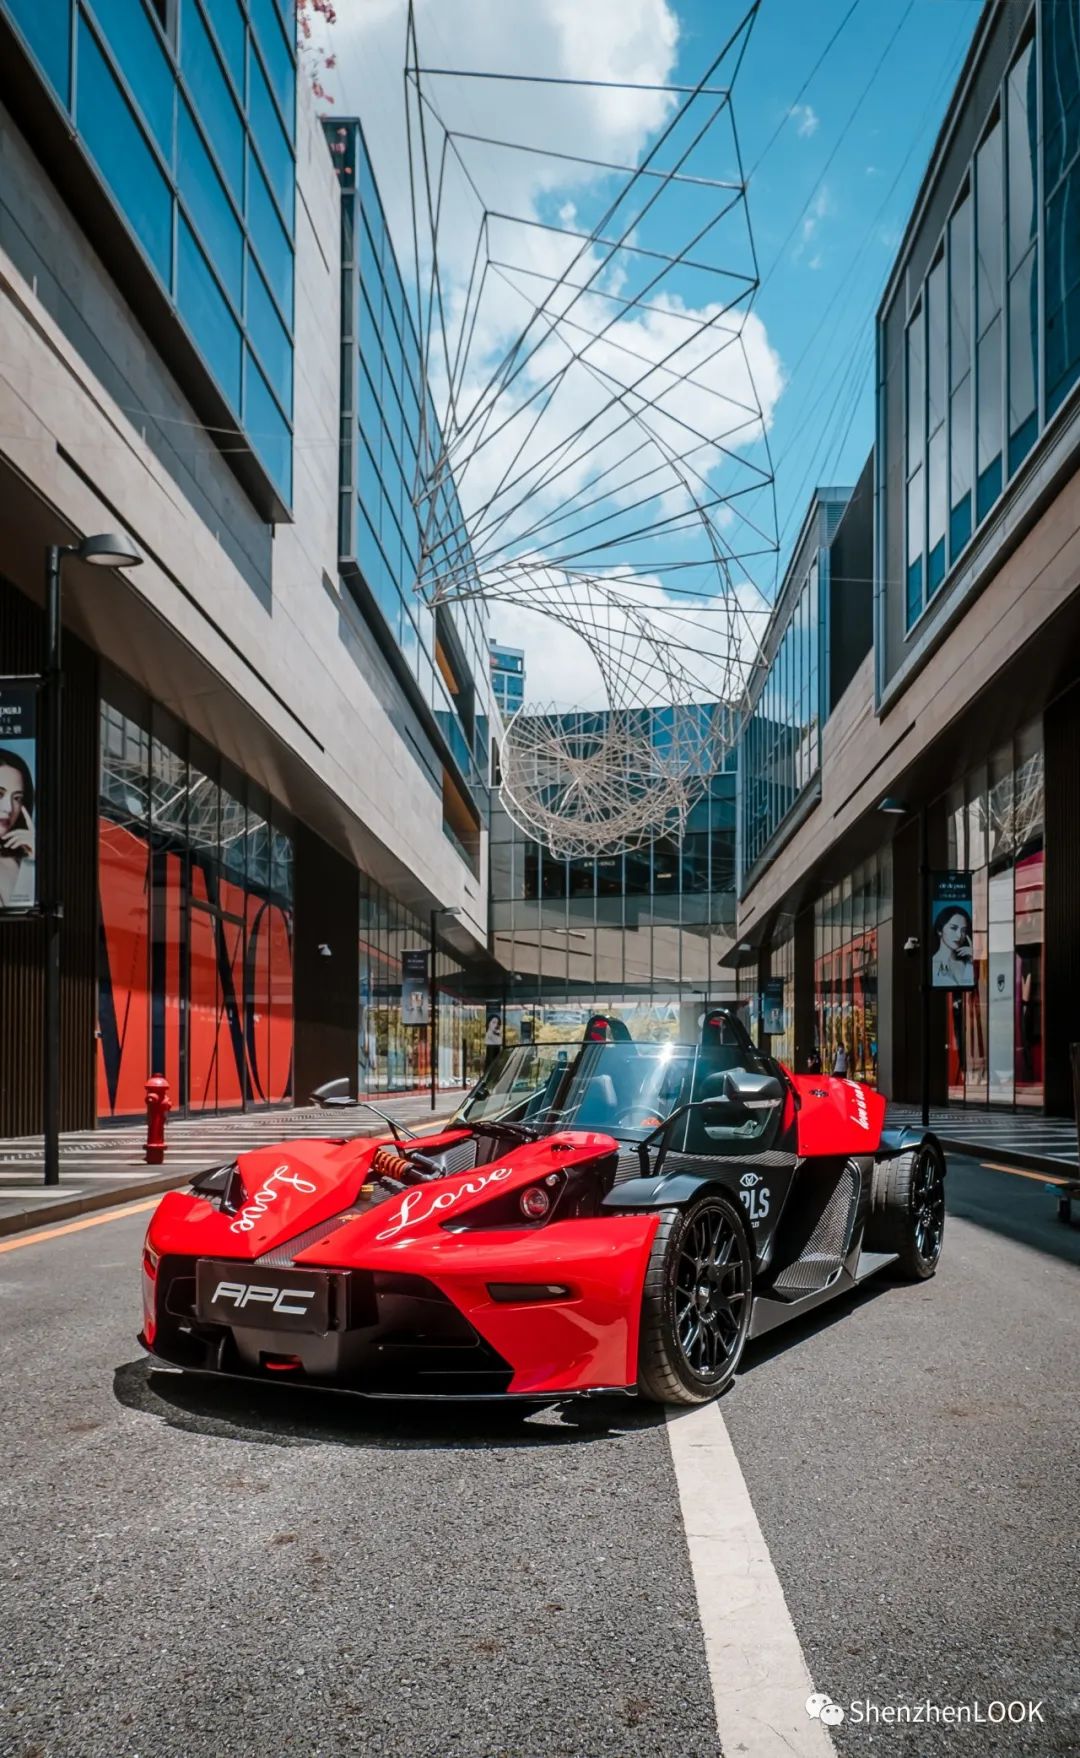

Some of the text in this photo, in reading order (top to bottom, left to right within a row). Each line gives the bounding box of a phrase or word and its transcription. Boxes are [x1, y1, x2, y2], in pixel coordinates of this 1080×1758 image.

[230, 1164, 317, 1234] Love
[375, 1167, 512, 1241] Love
[211, 1281, 315, 1315] APC
